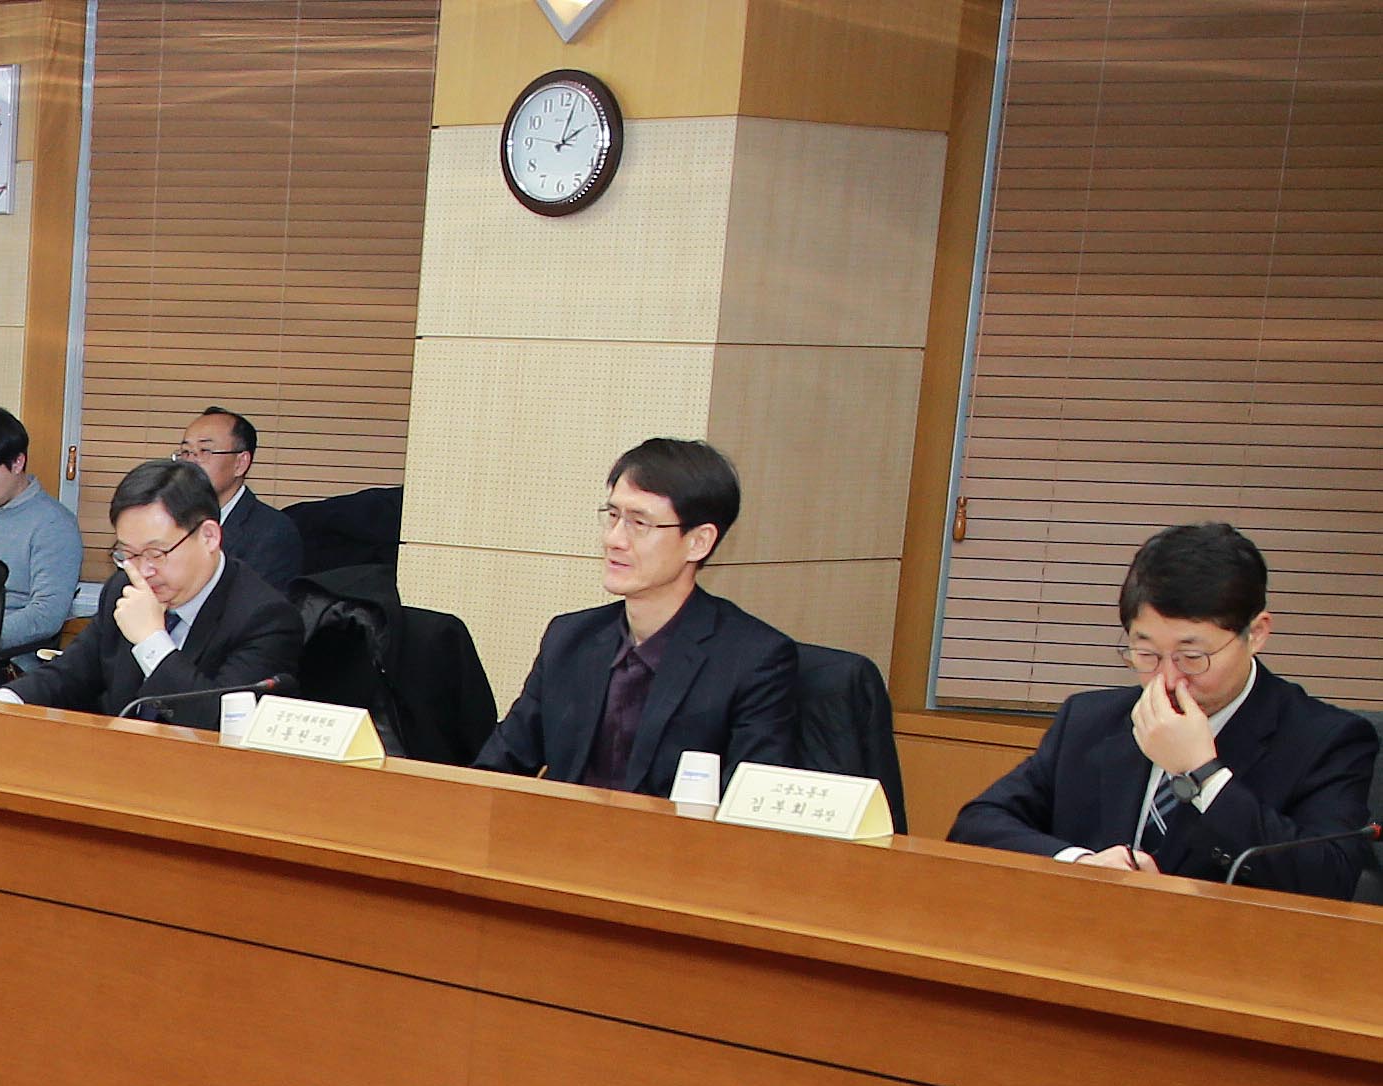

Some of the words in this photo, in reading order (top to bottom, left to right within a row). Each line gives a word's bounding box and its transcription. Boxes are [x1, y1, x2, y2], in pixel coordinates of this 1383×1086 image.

[543, 99, 554, 113] 11
[560, 93, 572, 107] 12
[529, 116, 542, 130] 10
[524, 137, 533, 150] 9
[527, 159, 537, 172] 8
[539, 175, 547, 188] 7
[556, 180, 565, 193] 6
[573, 173, 582, 188] 5
